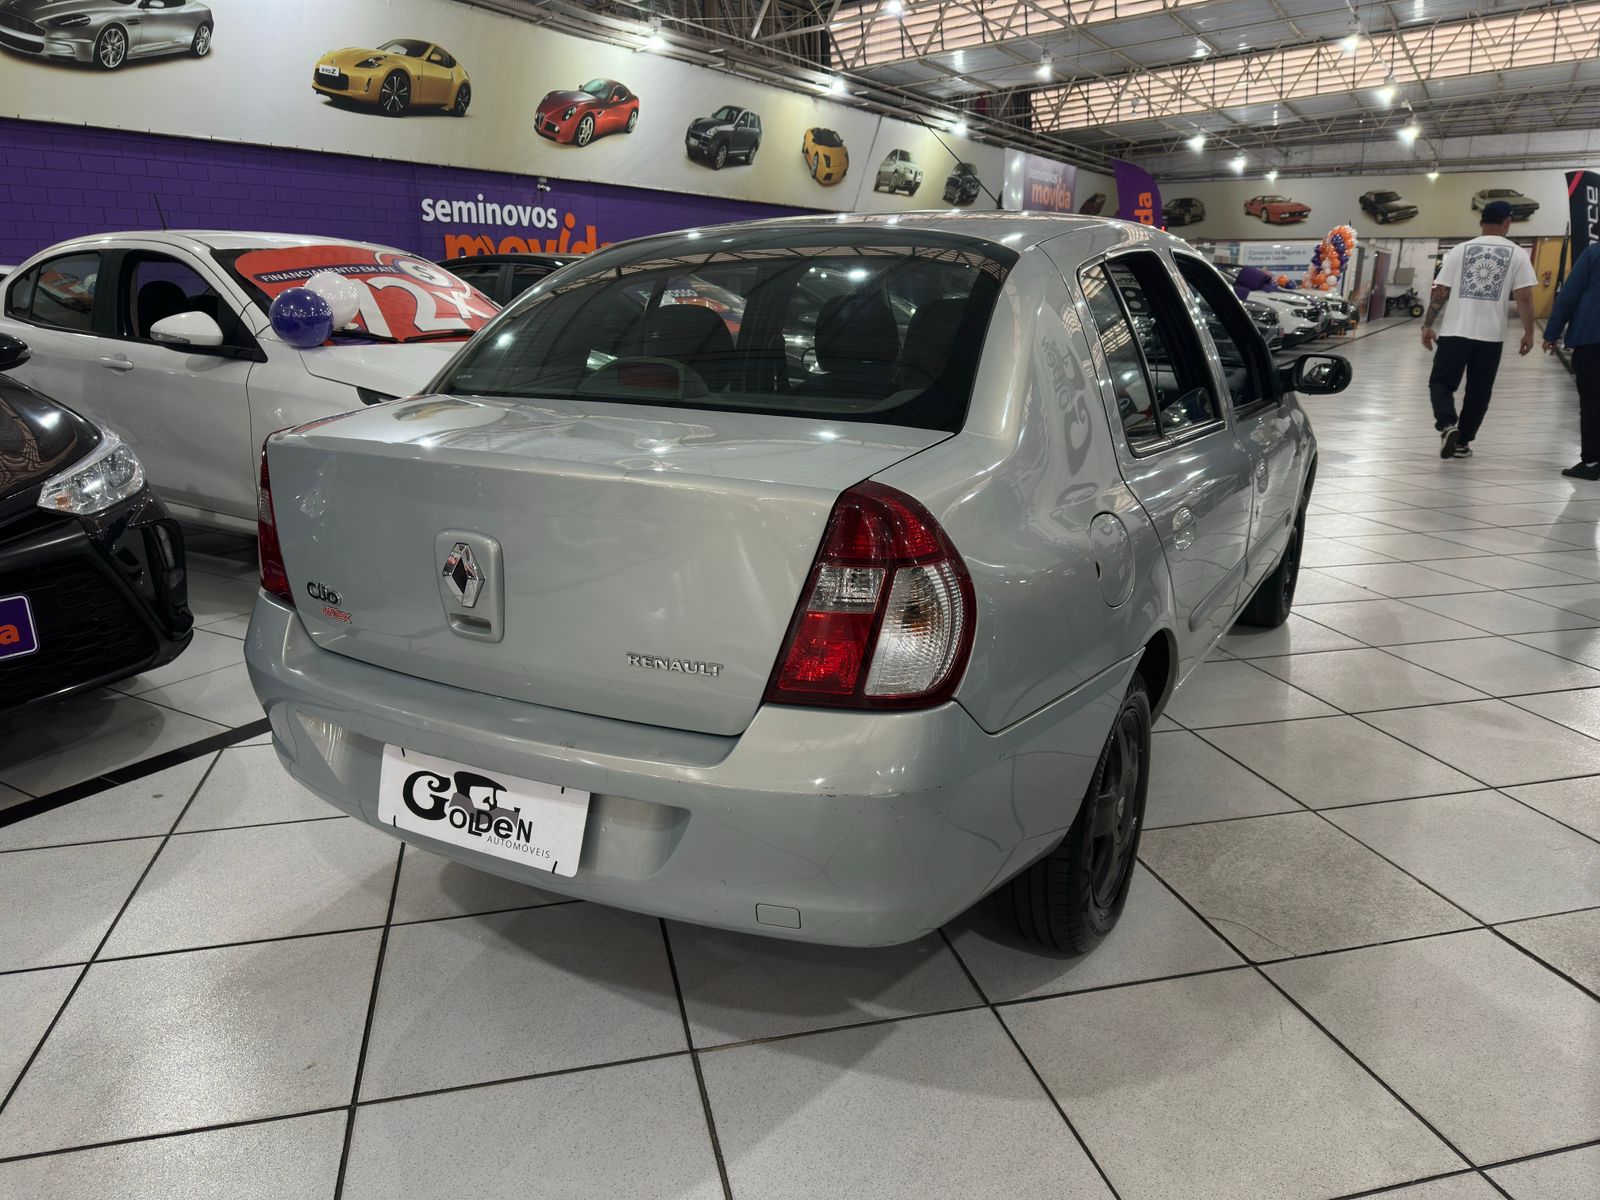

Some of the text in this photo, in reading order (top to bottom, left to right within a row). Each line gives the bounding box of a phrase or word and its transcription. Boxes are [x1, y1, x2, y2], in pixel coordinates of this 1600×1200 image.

[1031, 177, 1072, 211] movida
[420, 193, 558, 229] seminovos
[361, 265, 378, 274] EM
[307, 581, 341, 605] Clio
[626, 651, 724, 677] RENAULT
